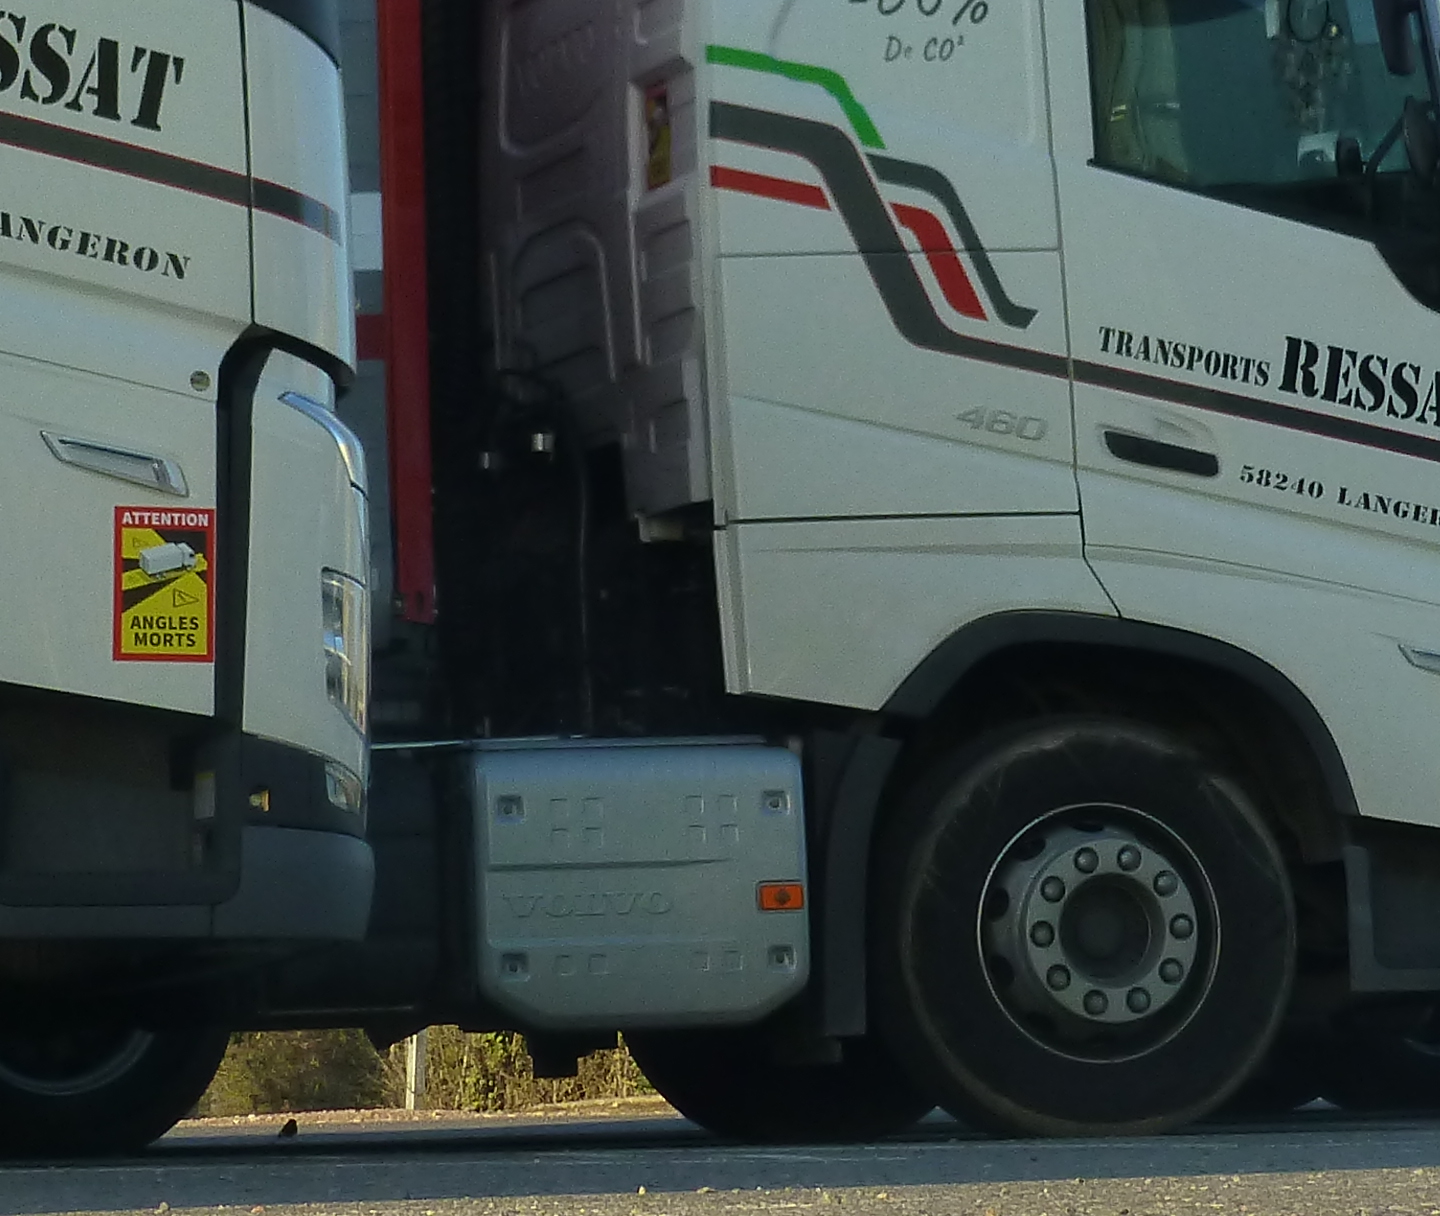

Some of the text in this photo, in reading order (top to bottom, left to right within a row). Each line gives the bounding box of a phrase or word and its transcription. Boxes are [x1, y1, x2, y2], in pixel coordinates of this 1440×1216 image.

[1098, 325, 1272, 388] TRANSPORTS
[954, 404, 1049, 442] 460
[1239, 464, 1325, 500] 58240
[121, 510, 210, 528] ATTENTION
[129, 614, 200, 632] ANGLES
[132, 631, 197, 649] MORTS
